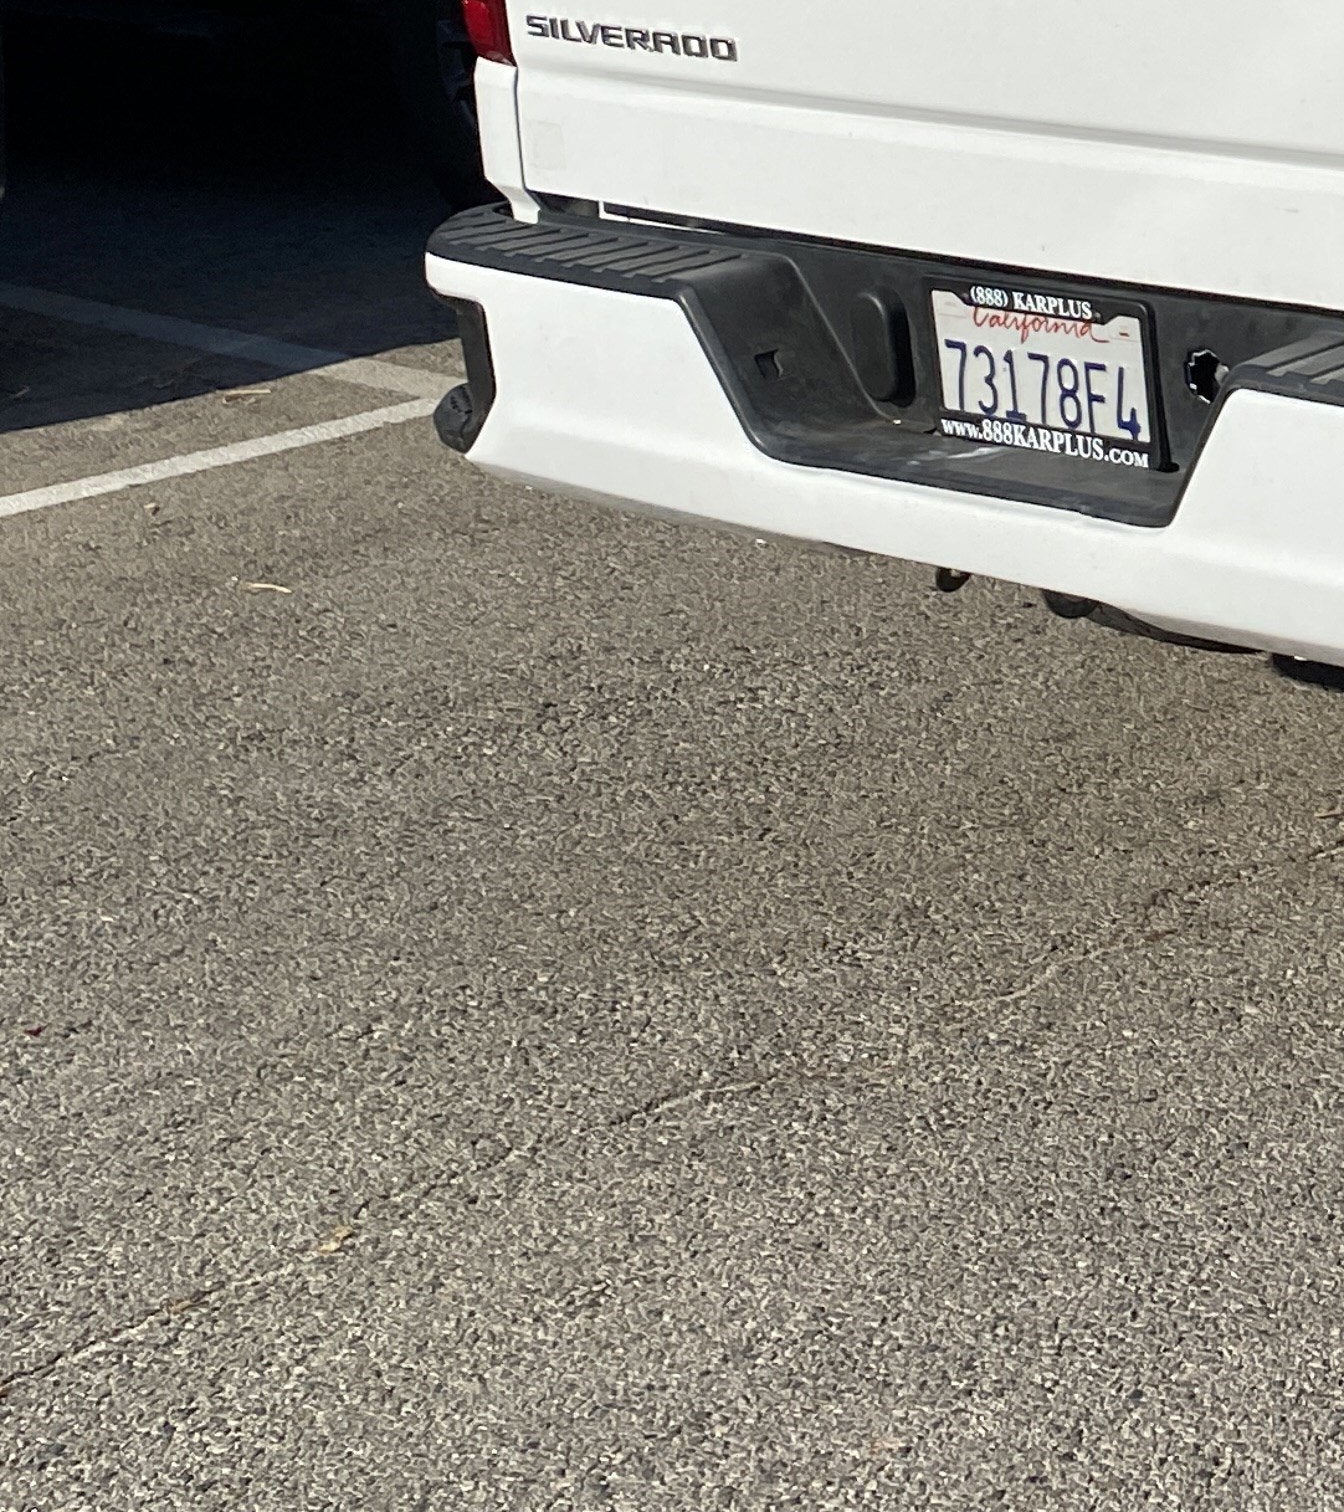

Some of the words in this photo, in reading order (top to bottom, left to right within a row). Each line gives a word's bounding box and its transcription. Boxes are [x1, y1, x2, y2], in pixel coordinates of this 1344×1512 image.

[526, 14, 738, 62] SILVERADO
[970, 286, 1009, 308] (888)
[1011, 291, 1093, 319] KARPLUS
[972, 307, 1110, 344] California
[944, 339, 1141, 441] 73178F4
